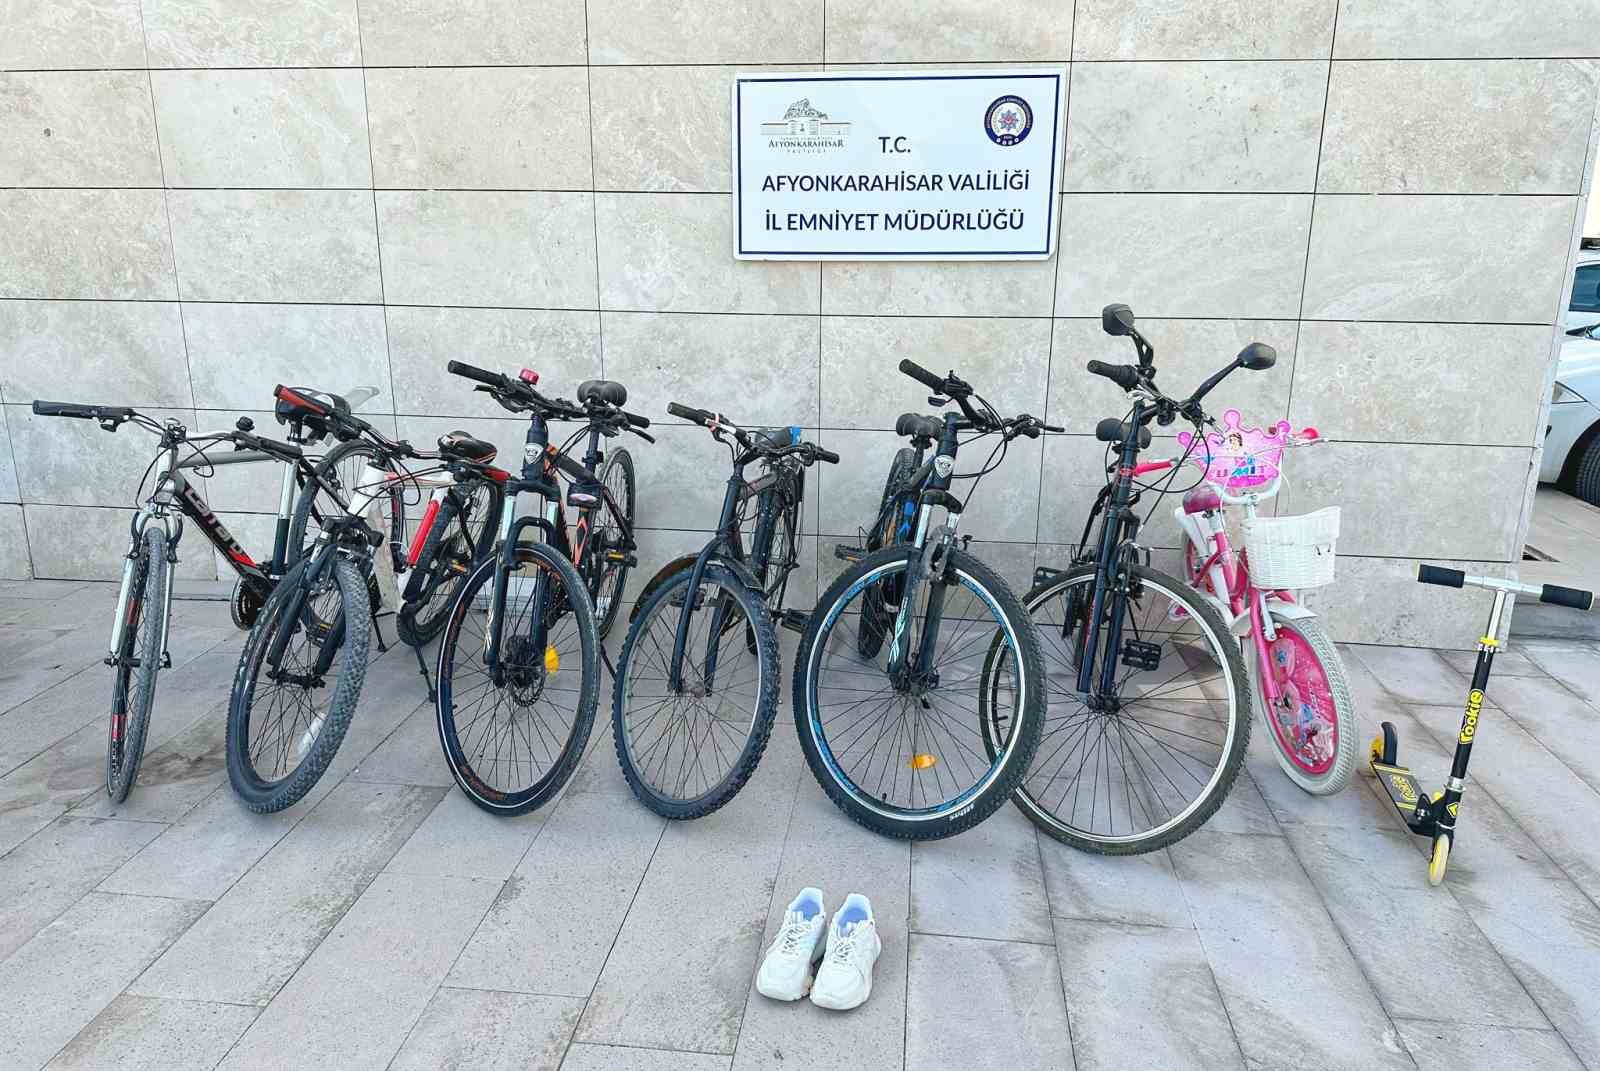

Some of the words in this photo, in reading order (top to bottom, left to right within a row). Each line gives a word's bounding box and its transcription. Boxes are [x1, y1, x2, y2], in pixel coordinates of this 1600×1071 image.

[878, 136, 911, 153] T.C.
[762, 170, 943, 192] AFYONKARAHİSAR
[948, 169, 1030, 191] VALİLİĞİ
[765, 209, 781, 231] İL
[787, 209, 879, 231] EMNİYET
[884, 208, 1024, 231] MÜDÜRLÜĞÜ
